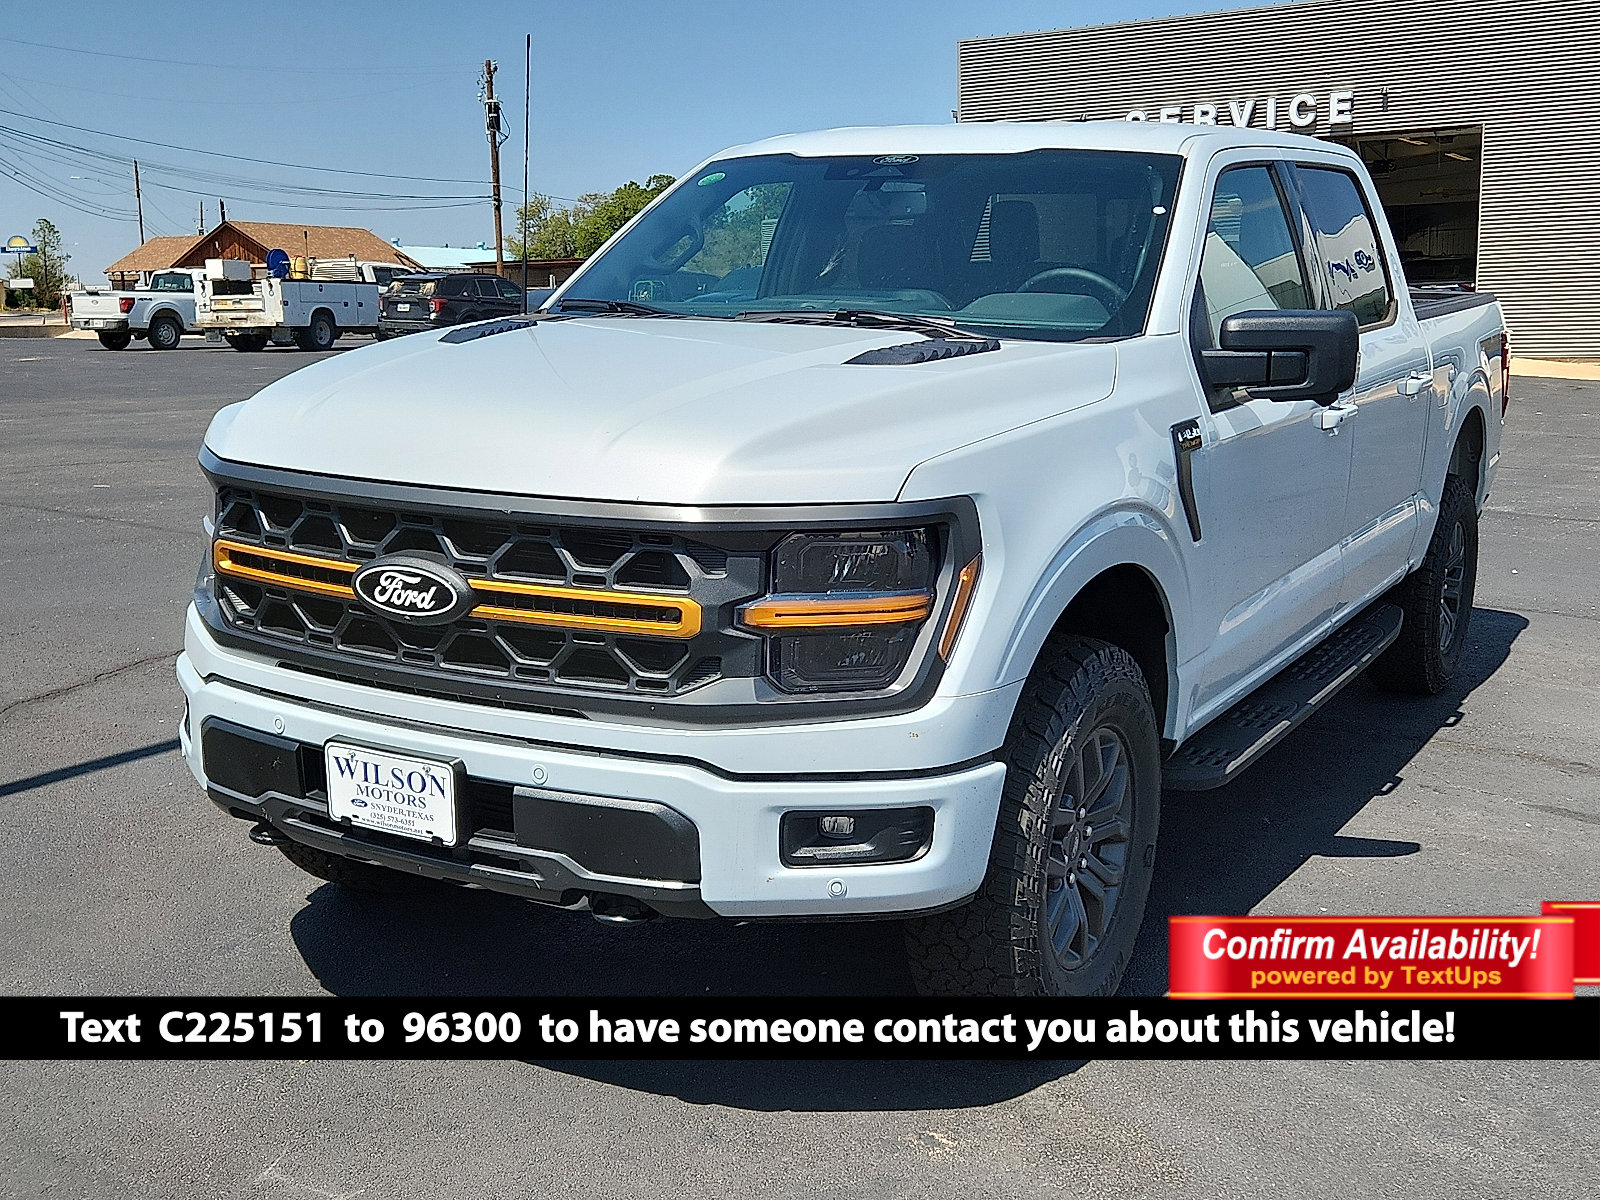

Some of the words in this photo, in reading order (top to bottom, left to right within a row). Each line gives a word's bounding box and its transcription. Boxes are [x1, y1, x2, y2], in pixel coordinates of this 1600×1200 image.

[373, 571, 438, 610] Ford
[333, 755, 447, 800] WILSON
[356, 784, 427, 810] MOTORS
[369, 812, 386, 821] (325)
[370, 802, 435, 822] SNYDER,TEXAS
